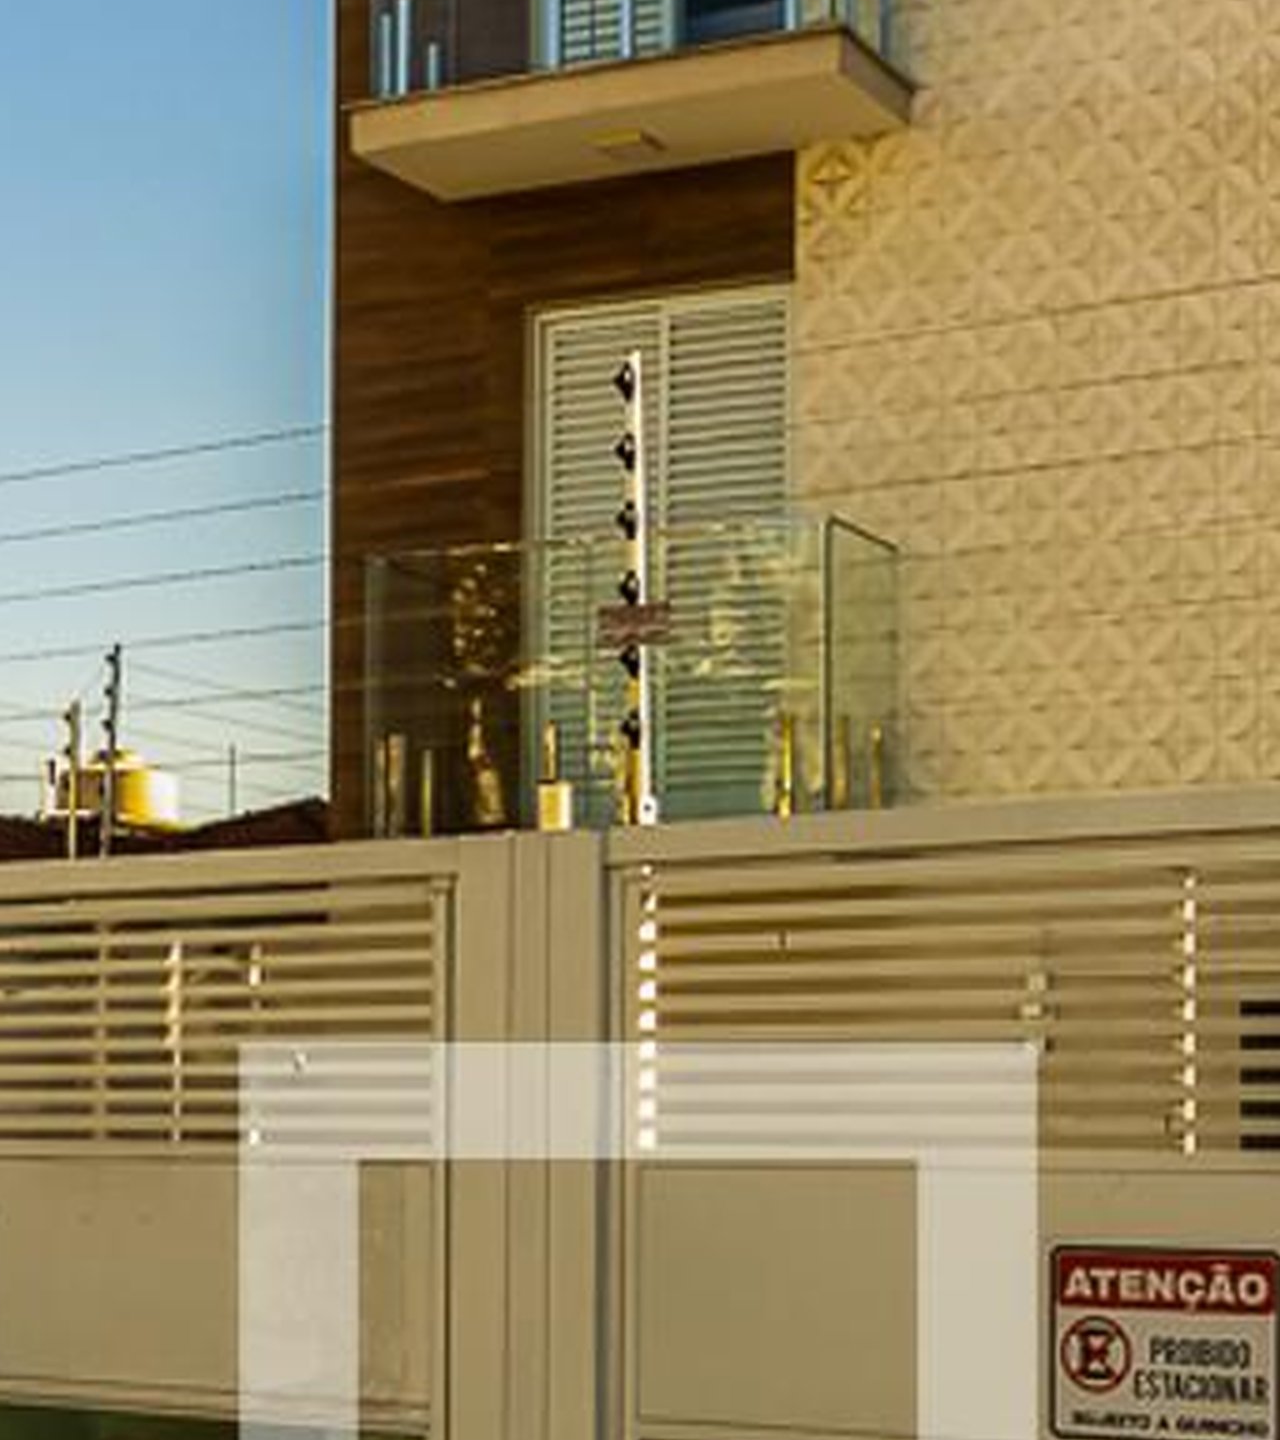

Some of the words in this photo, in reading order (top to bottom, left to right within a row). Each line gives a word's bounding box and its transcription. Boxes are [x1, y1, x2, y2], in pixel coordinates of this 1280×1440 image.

[1064, 1264, 1267, 1311] ATENÇÃO
[1149, 1335, 1251, 1369] PROIBIDO
[1133, 1368, 1269, 1403] ESTACIONAR
